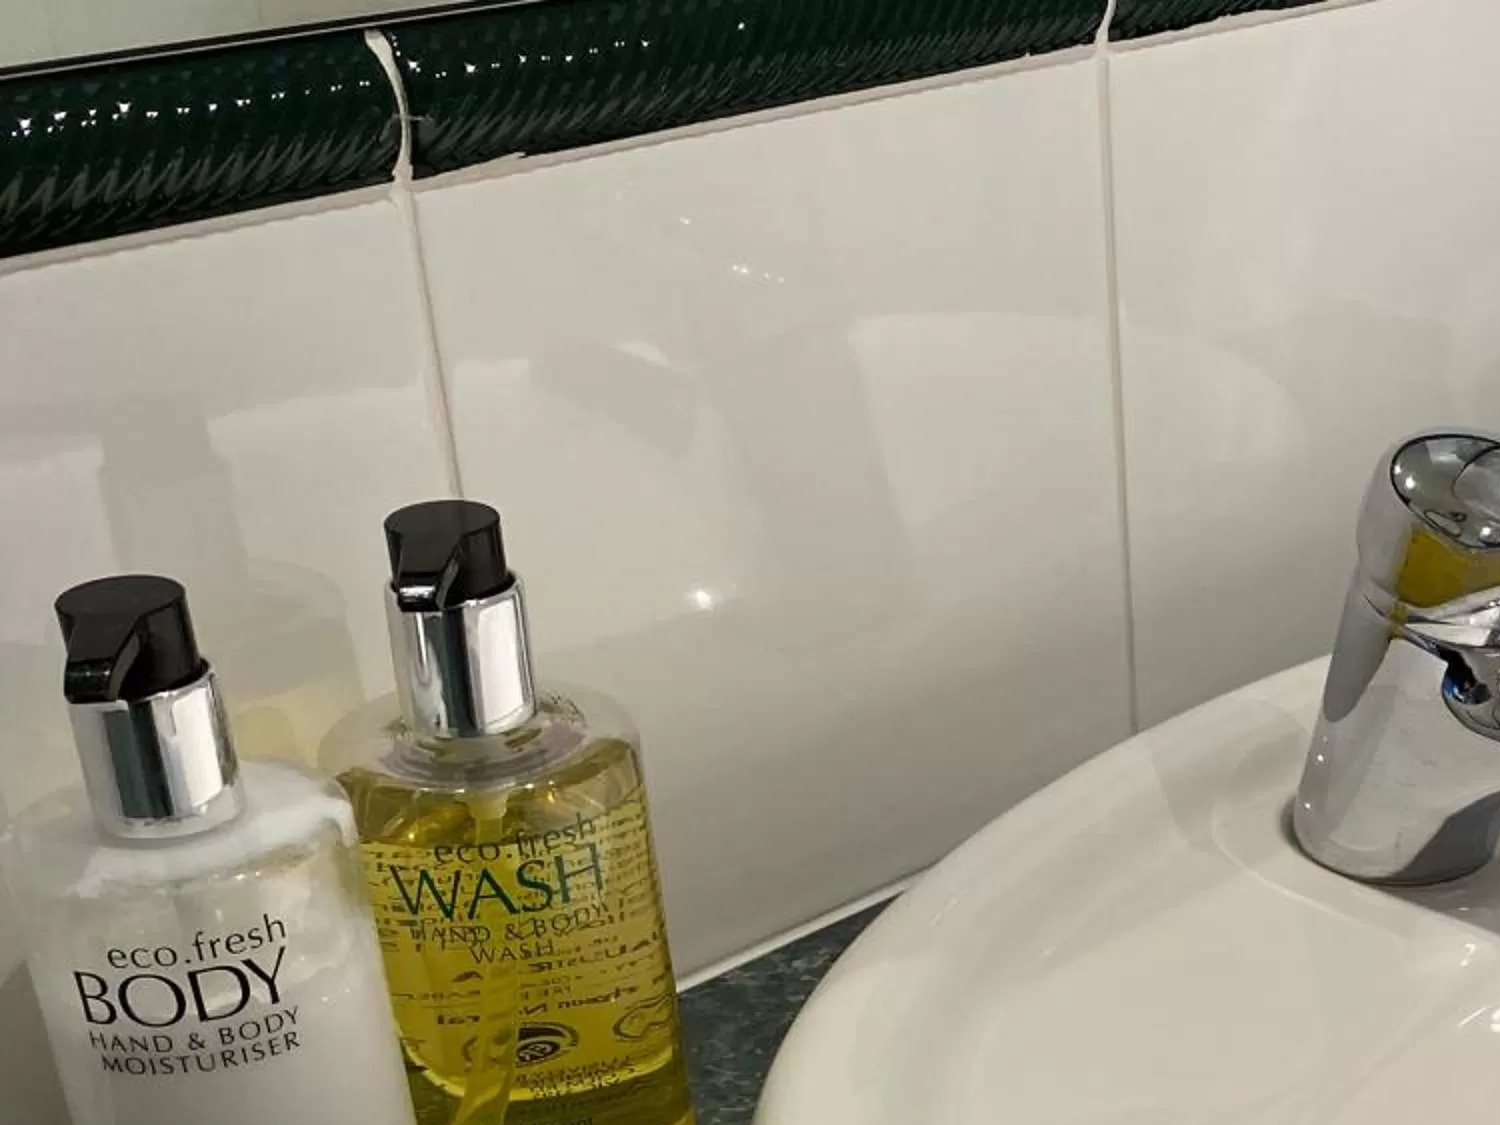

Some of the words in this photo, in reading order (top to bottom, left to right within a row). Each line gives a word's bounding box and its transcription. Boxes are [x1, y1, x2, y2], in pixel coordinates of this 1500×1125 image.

[433, 812, 598, 865] eco.fresh
[390, 842, 603, 921] WASH
[106, 913, 287, 969] eco.fresh
[409, 922, 491, 944] HAND
[504, 925, 527, 940] &
[534, 900, 610, 938] BODY
[469, 942, 554, 964] WASH
[74, 945, 287, 1027] BODY
[88, 1031, 174, 1054] HAND
[187, 1032, 207, 1051] &
[218, 1005, 300, 1047] BODY
[101, 1031, 301, 1077] MOISTURISER
